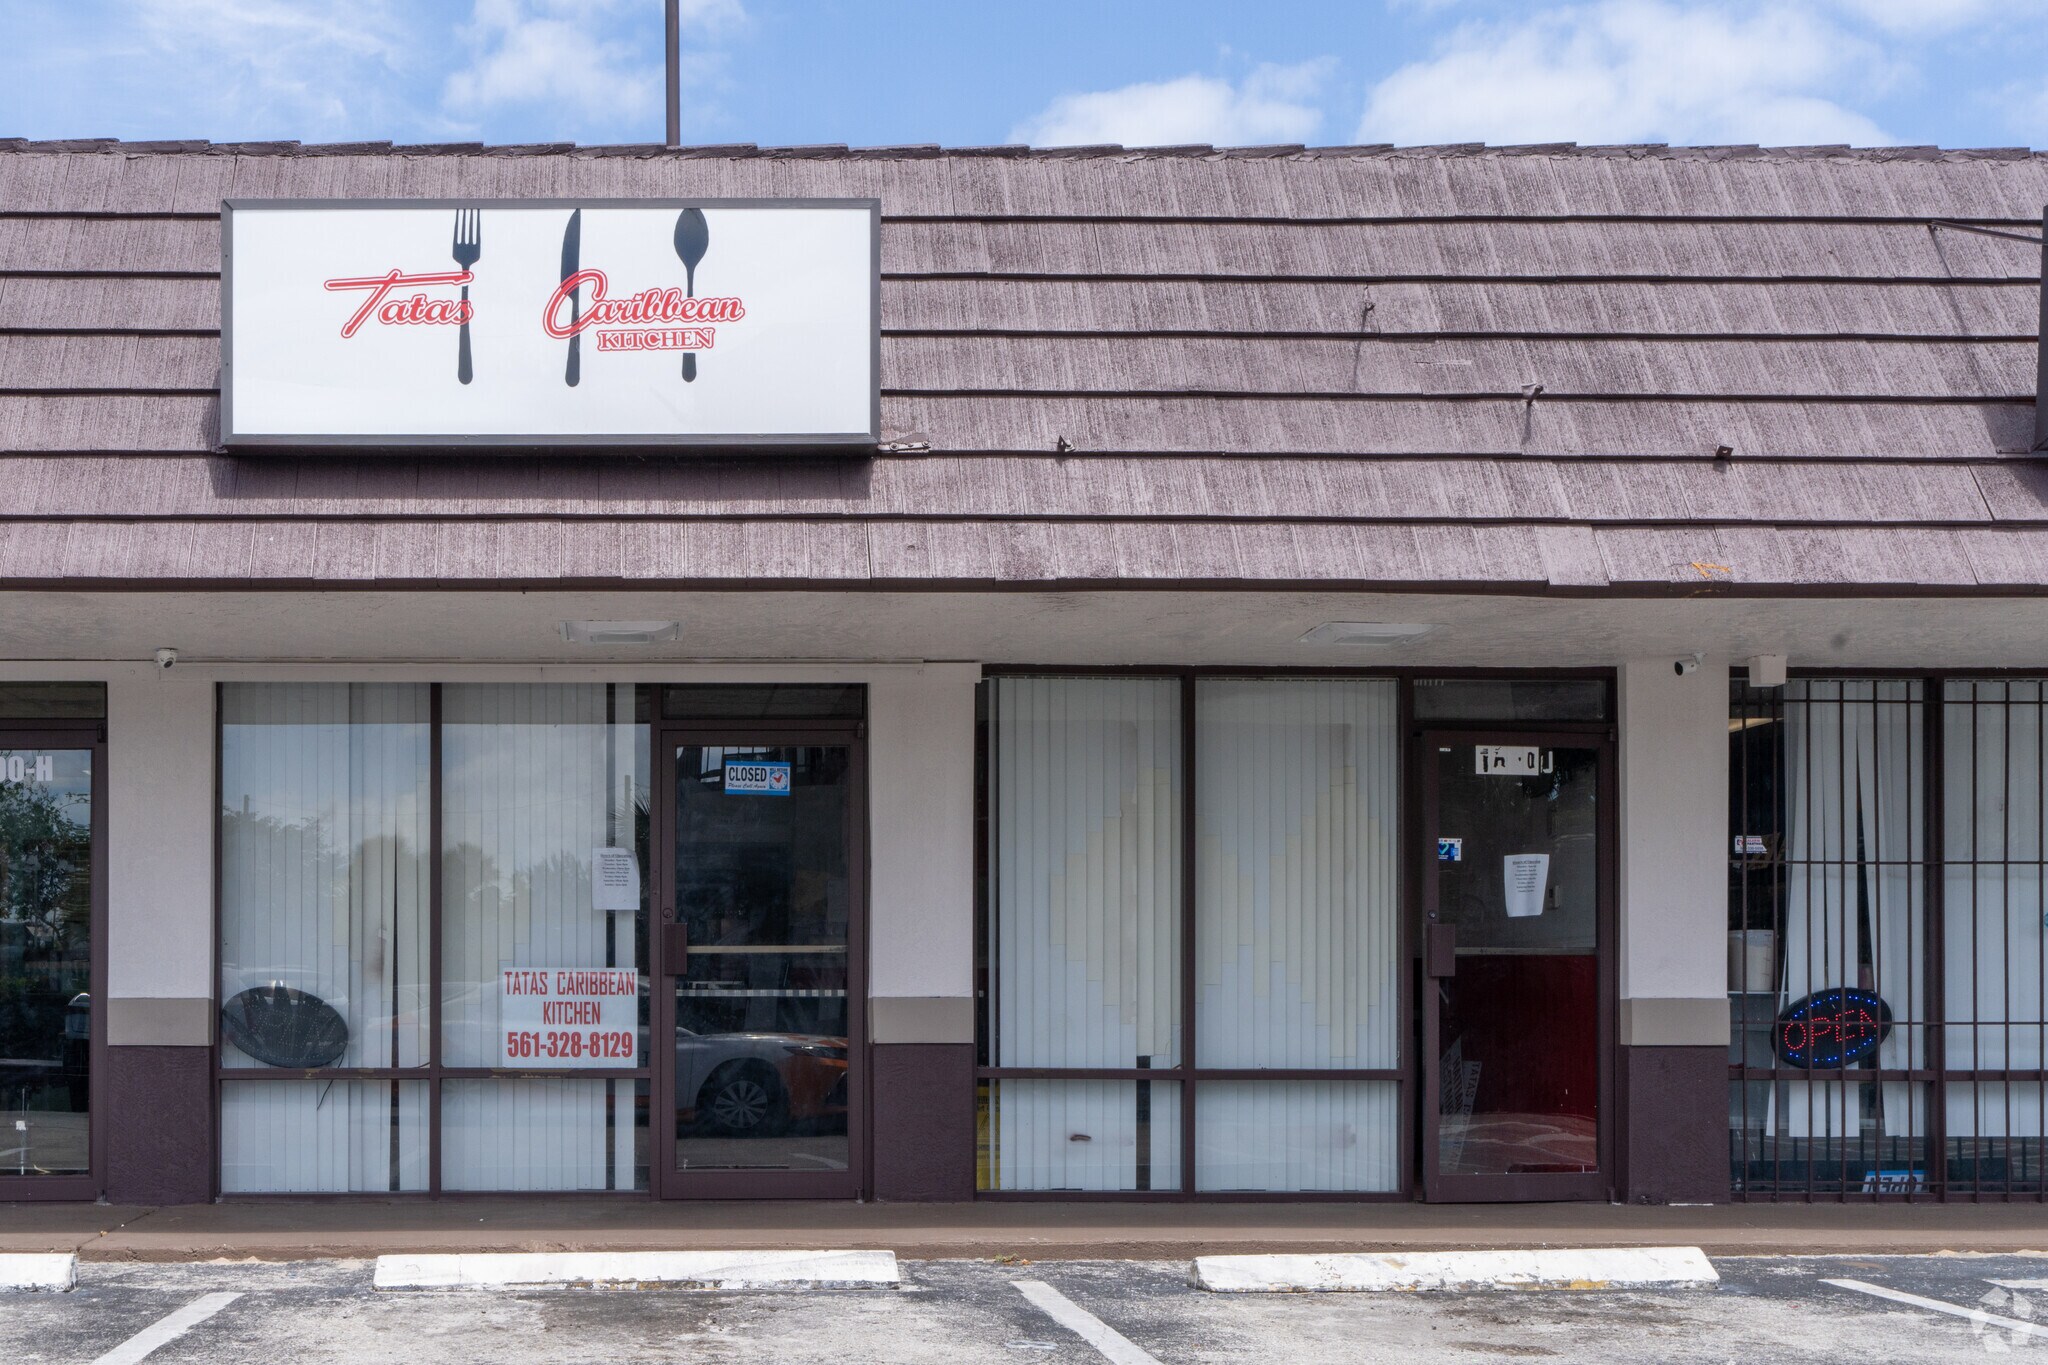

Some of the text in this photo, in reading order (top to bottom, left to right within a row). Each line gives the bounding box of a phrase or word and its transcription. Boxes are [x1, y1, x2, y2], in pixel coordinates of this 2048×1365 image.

[324, 268, 745, 339] Tatas Caribbean
[597, 327, 715, 351] KITCHEN
[728, 767, 767, 782] CLOSED
[504, 971, 635, 996] TATAS CARIBBEAN
[543, 1001, 601, 1025] KITCHEN
[507, 1031, 633, 1058] 561-328-8129
